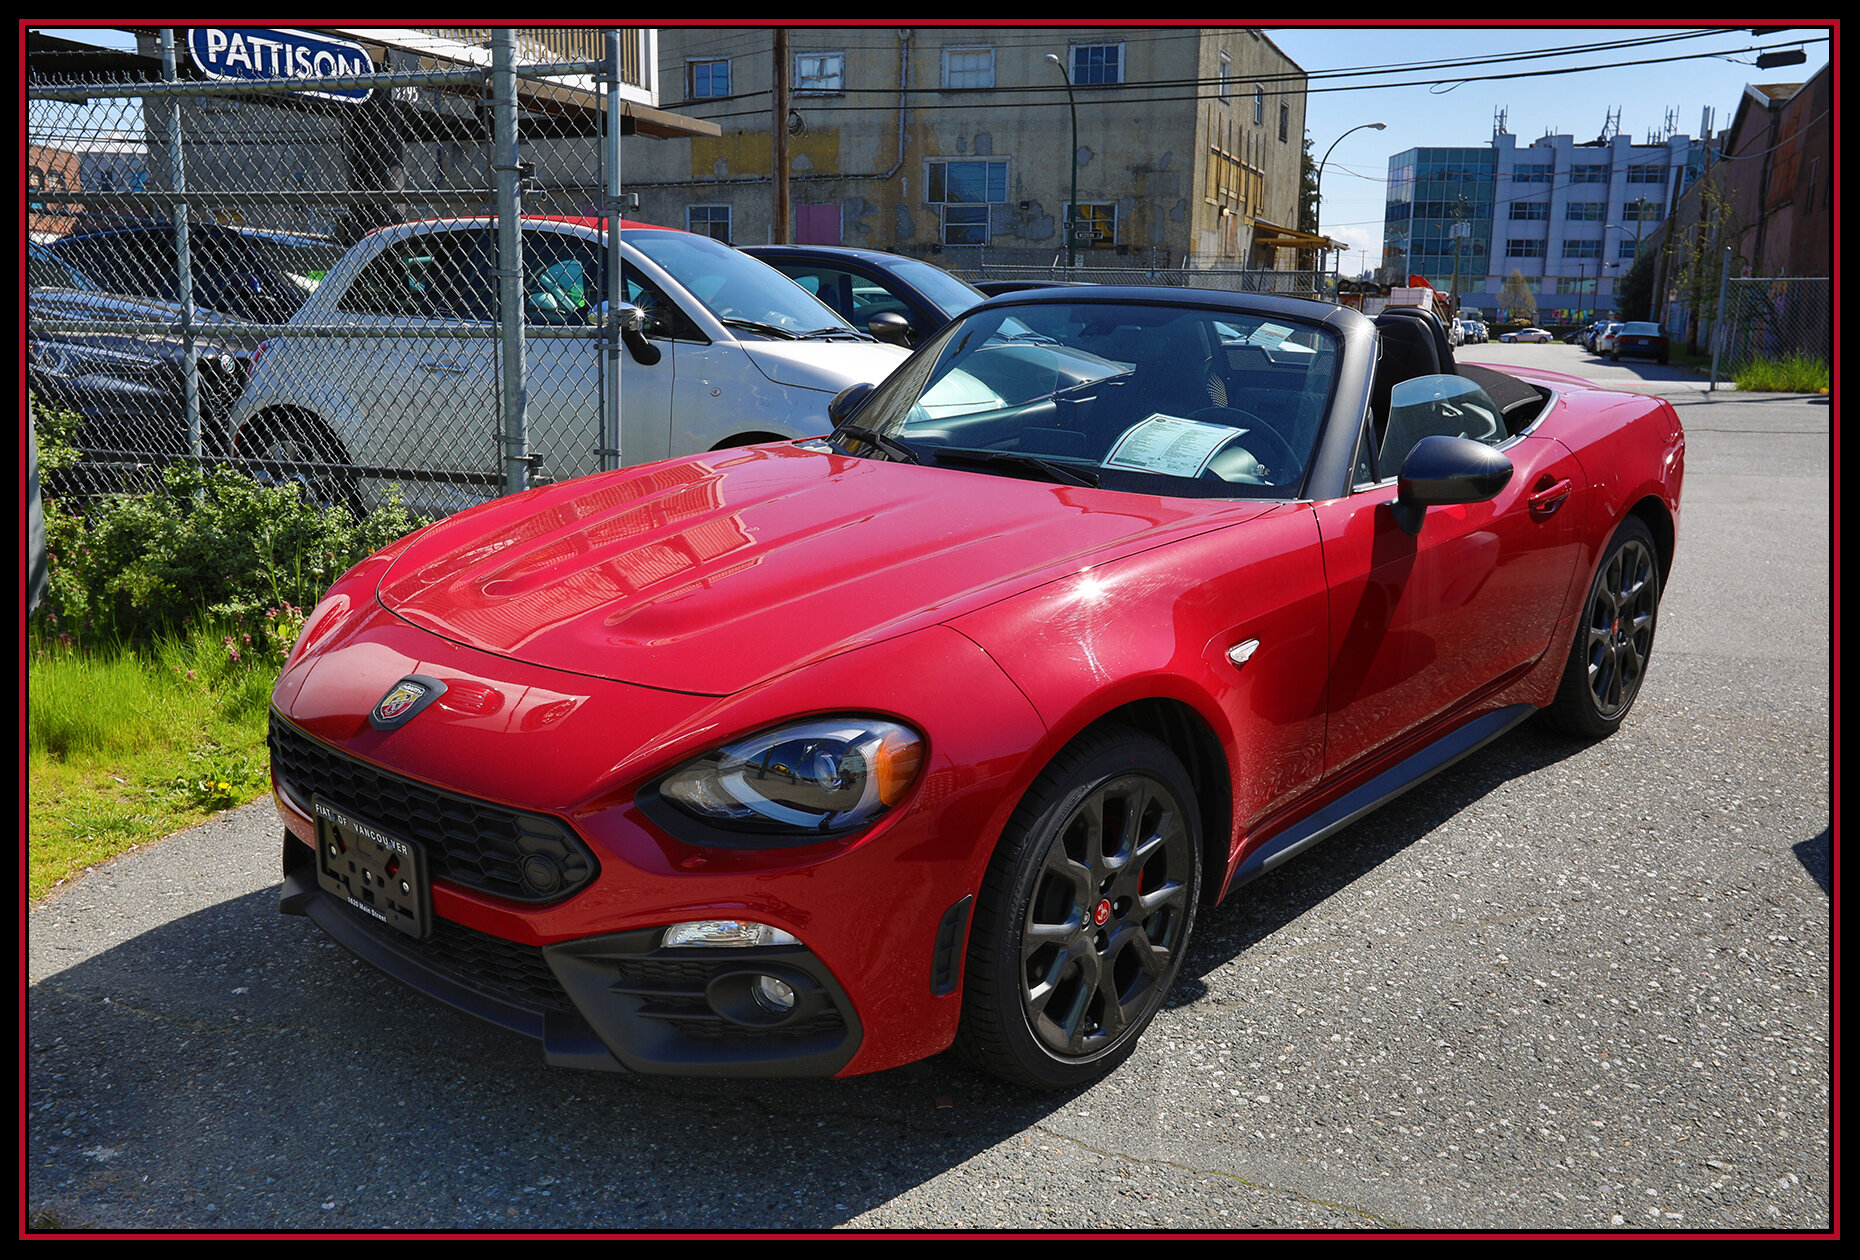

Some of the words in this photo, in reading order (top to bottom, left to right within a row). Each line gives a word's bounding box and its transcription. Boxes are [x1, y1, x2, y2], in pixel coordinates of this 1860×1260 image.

[206, 29, 361, 79] PATTISON
[315, 803, 331, 817] FIAT
[337, 815, 348, 826] OF
[353, 823, 408, 855] VANCOUVER
